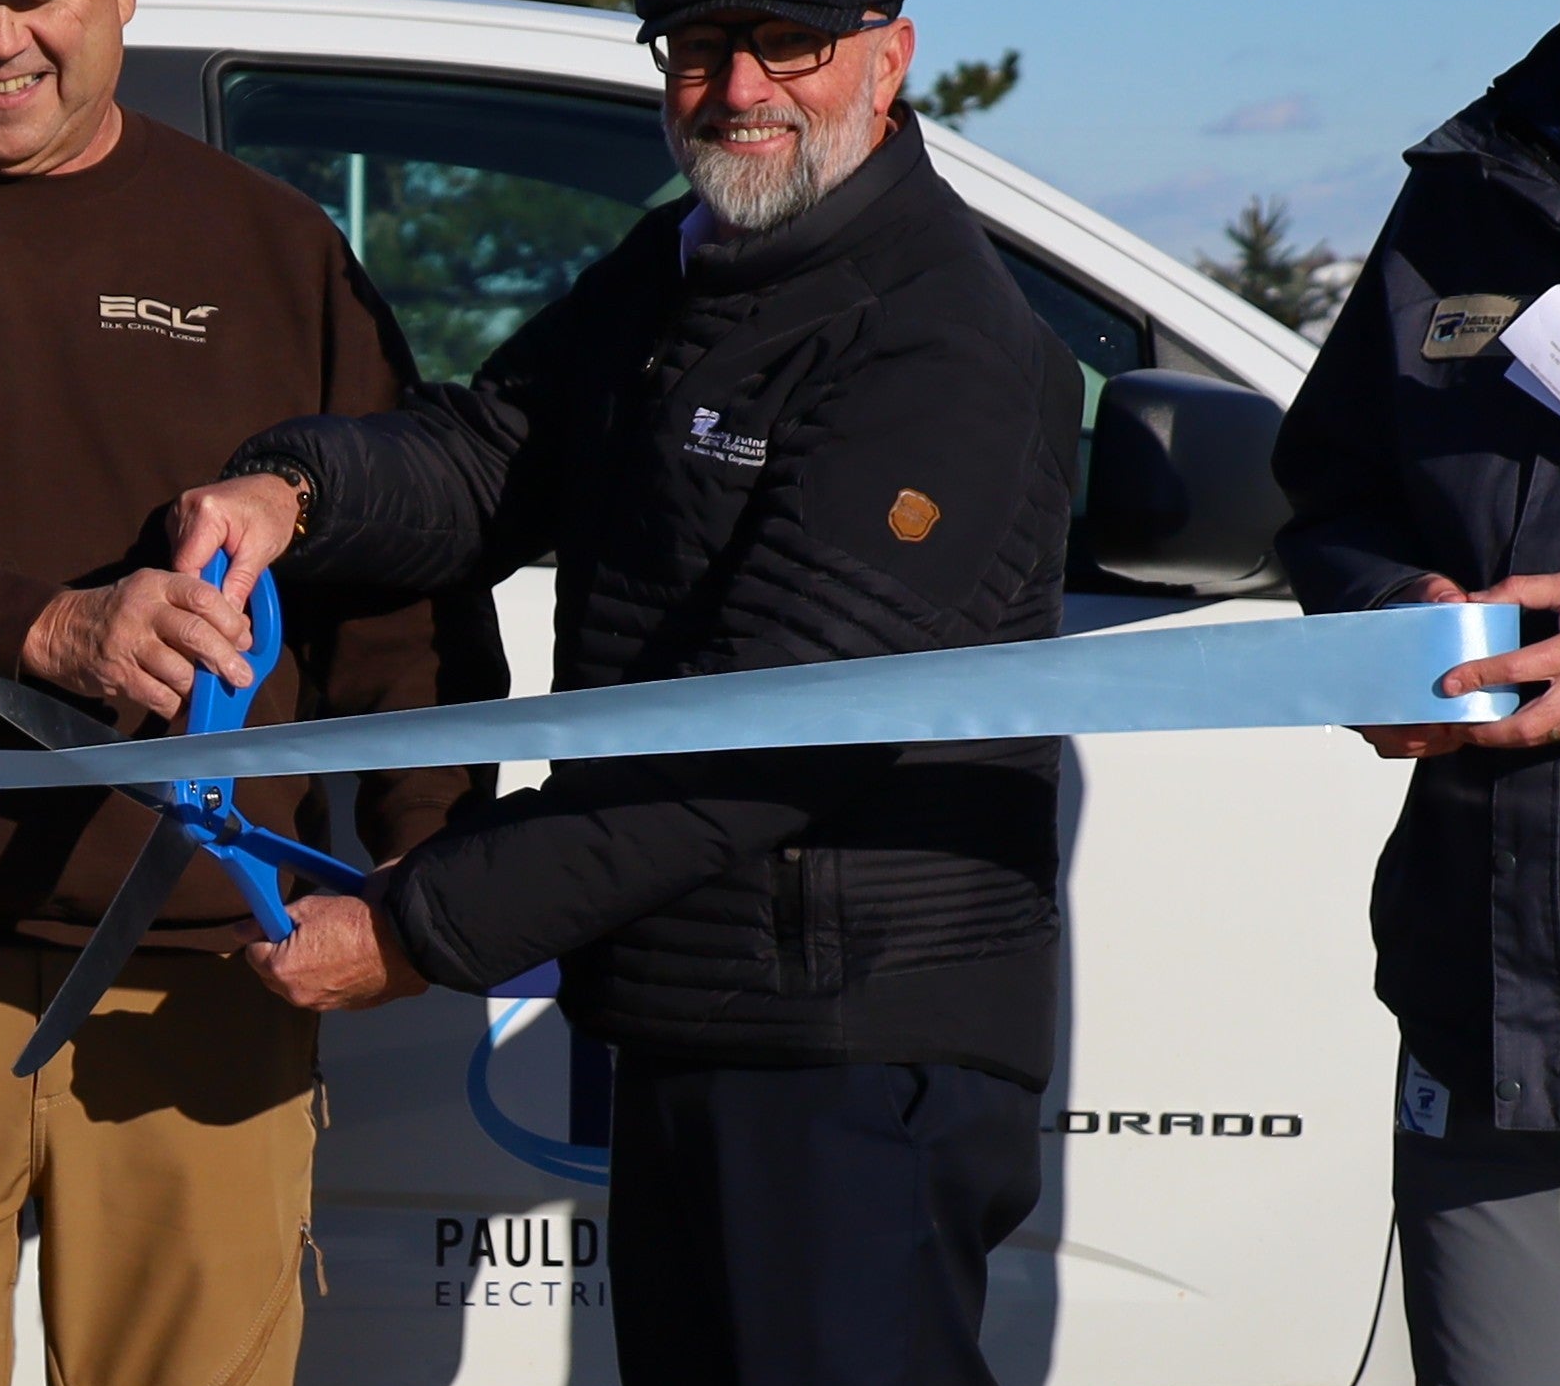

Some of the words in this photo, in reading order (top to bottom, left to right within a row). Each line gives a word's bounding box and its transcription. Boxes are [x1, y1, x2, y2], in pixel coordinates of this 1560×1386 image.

[100, 295, 206, 332] ECL
[1041, 1111, 1303, 1138] ORADO
[435, 1217, 598, 1268] PAULD
[435, 1281, 604, 1307] ELECTRI
